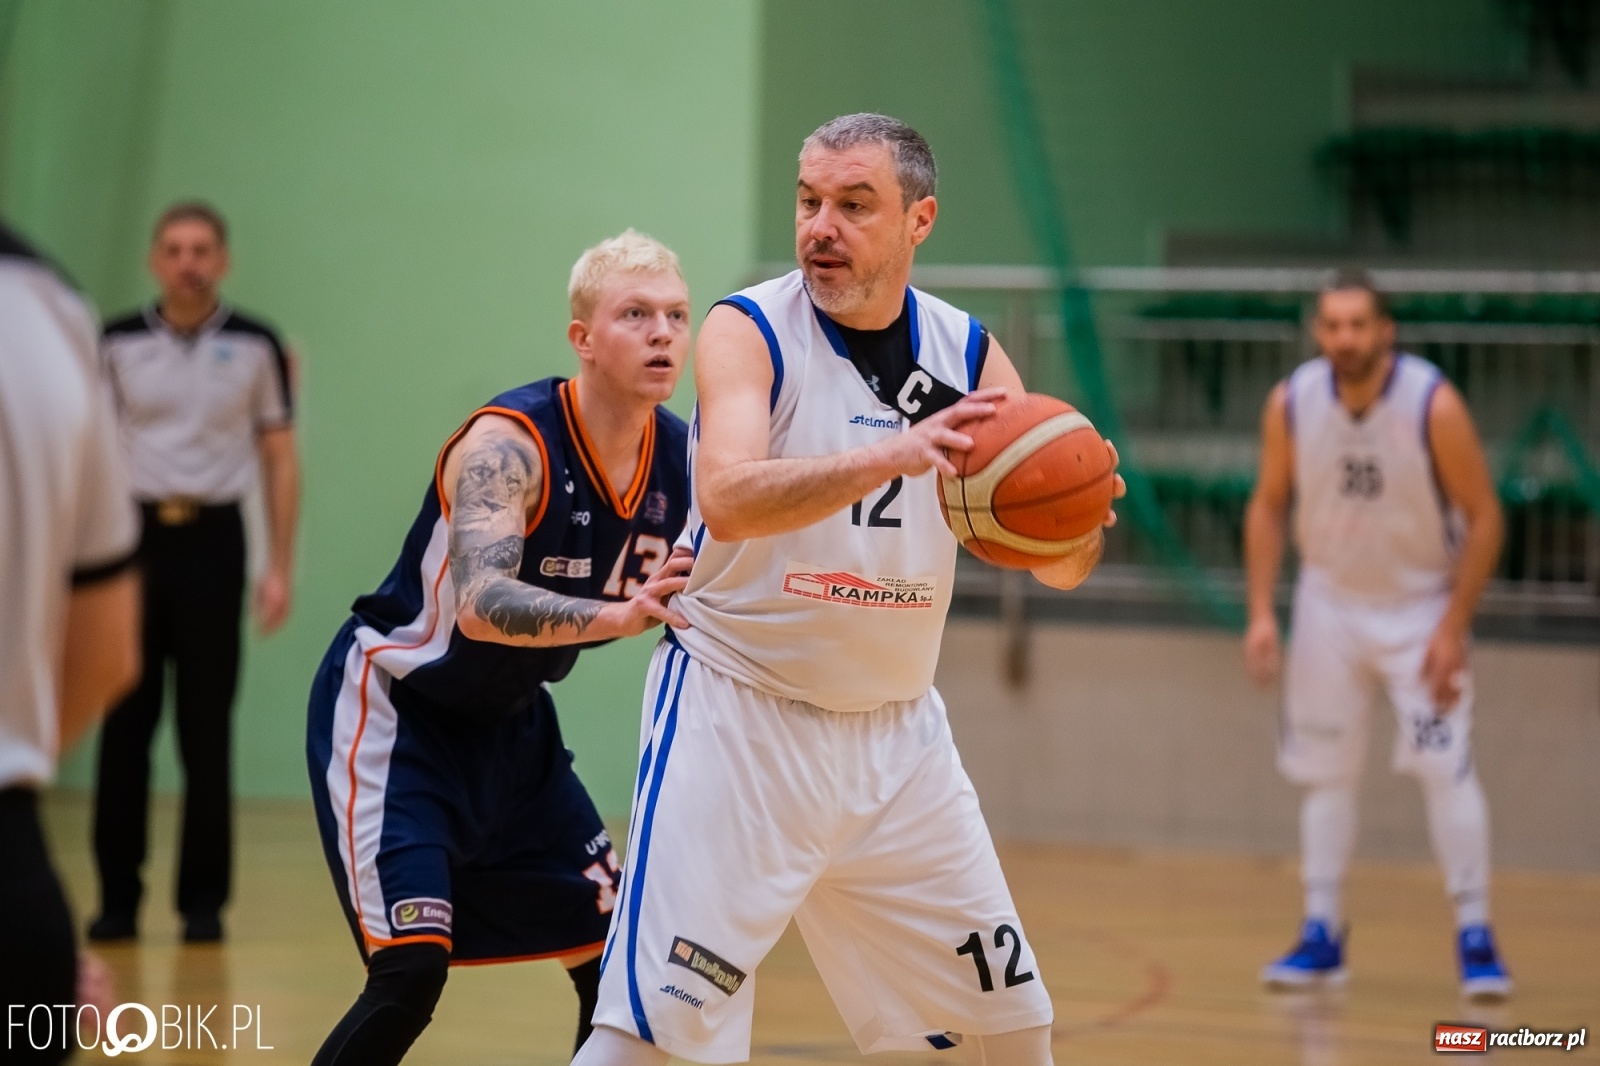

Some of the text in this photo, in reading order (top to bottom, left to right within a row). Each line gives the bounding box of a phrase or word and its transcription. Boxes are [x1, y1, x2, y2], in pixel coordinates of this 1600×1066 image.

[897, 369, 933, 415] C
[602, 532, 669, 600] 13
[831, 585, 918, 603] KAMPKA
[423, 906, 451, 925] Energ
[956, 923, 1035, 992] 12
[660, 985, 704, 1010] stelman
